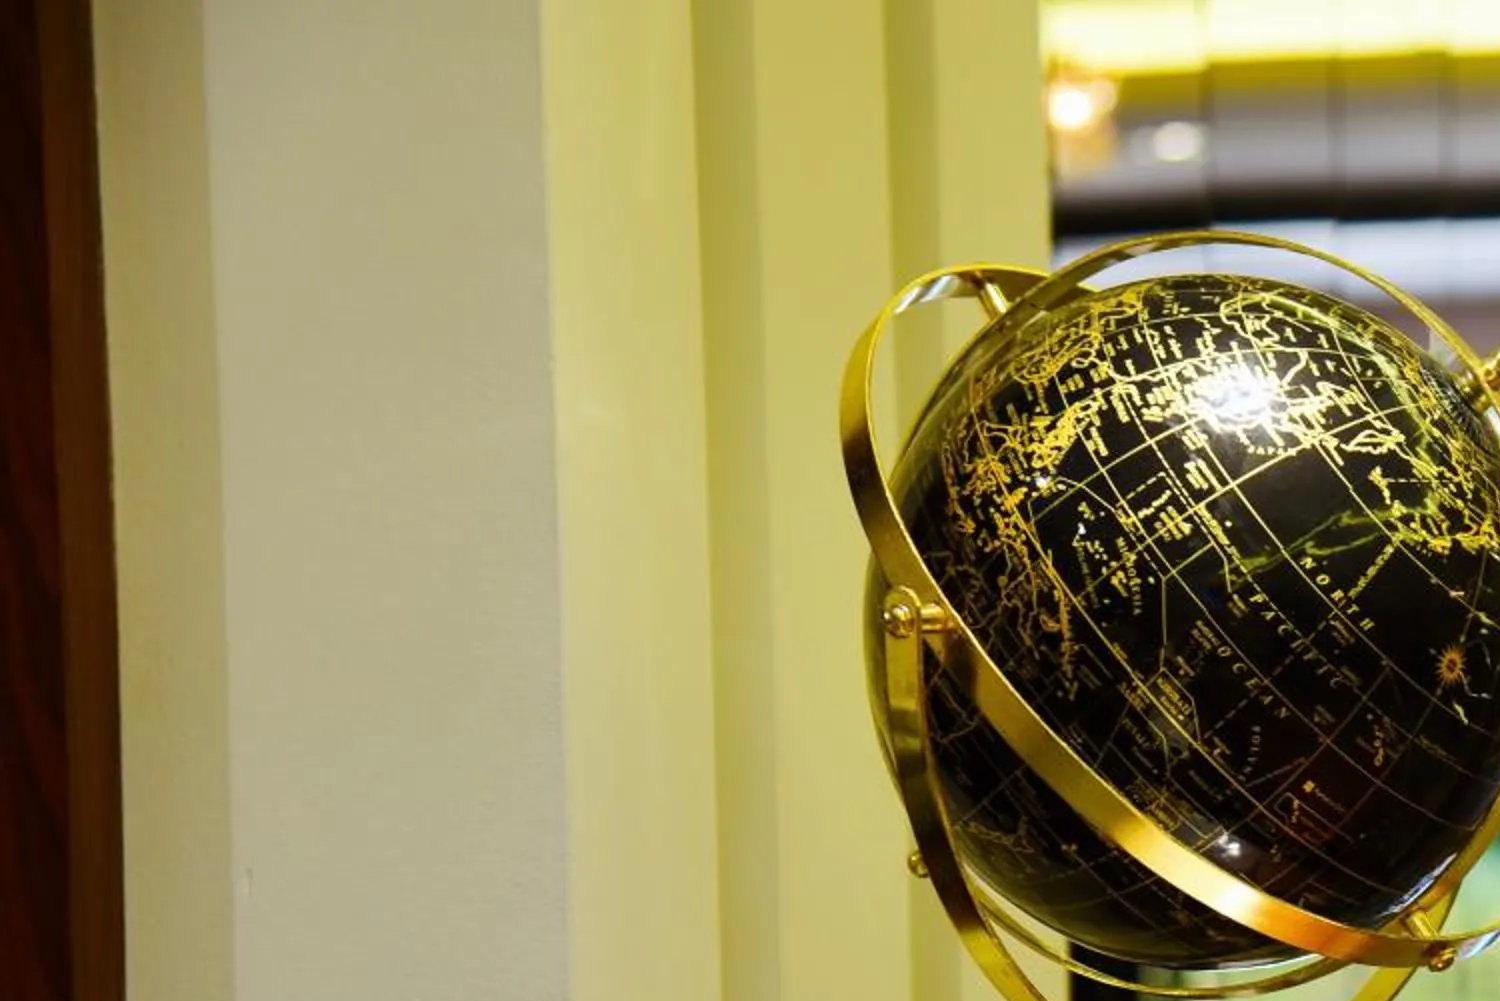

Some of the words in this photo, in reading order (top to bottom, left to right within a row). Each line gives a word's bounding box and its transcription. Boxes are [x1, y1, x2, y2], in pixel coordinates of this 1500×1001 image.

[1299, 556, 1376, 632] NORTH
[1248, 592, 1343, 689] PACIFIC
[1216, 645, 1293, 719] OCEAN
